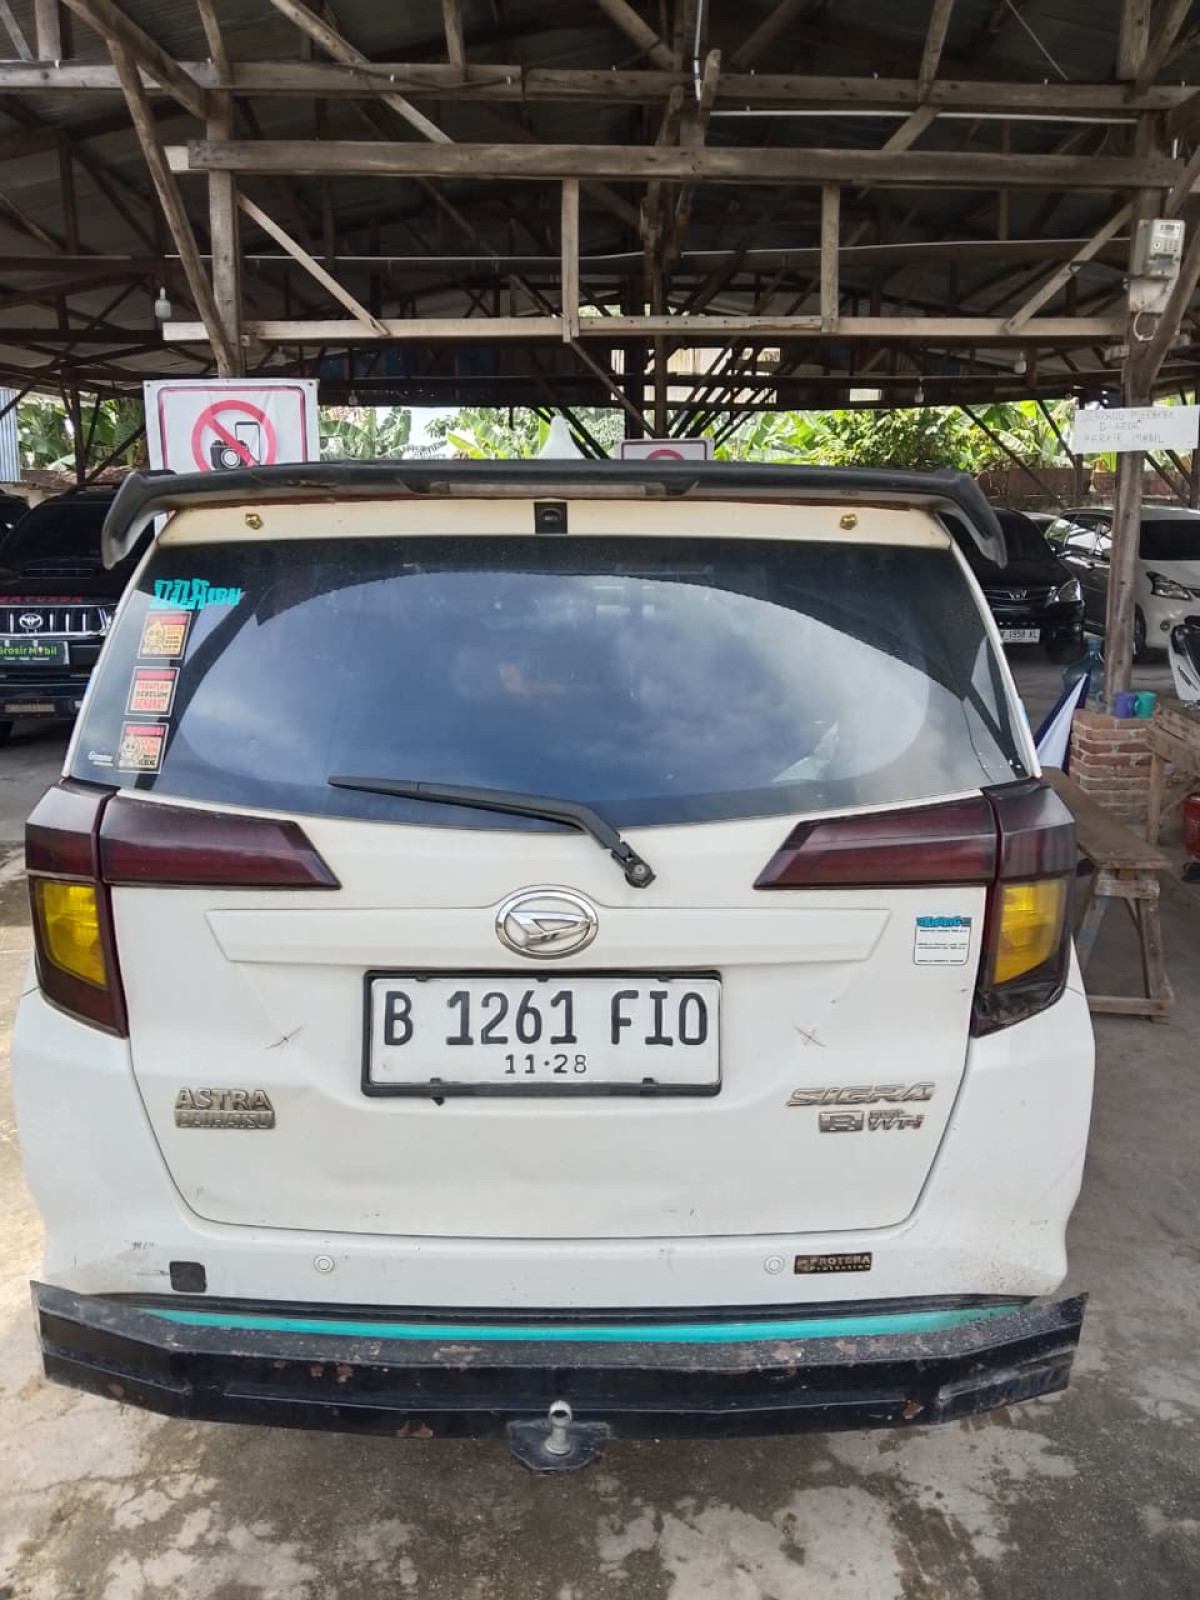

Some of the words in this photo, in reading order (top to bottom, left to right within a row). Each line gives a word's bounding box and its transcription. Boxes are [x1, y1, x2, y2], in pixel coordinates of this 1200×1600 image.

[384, 991, 414, 1046] B
[446, 990, 577, 1046] 1261
[611, 990, 708, 1046] FIO
[175, 1088, 273, 1111] ASTRA
[785, 1081, 935, 1107] SIGRA
[177, 1110, 275, 1129] DAIHATSU
